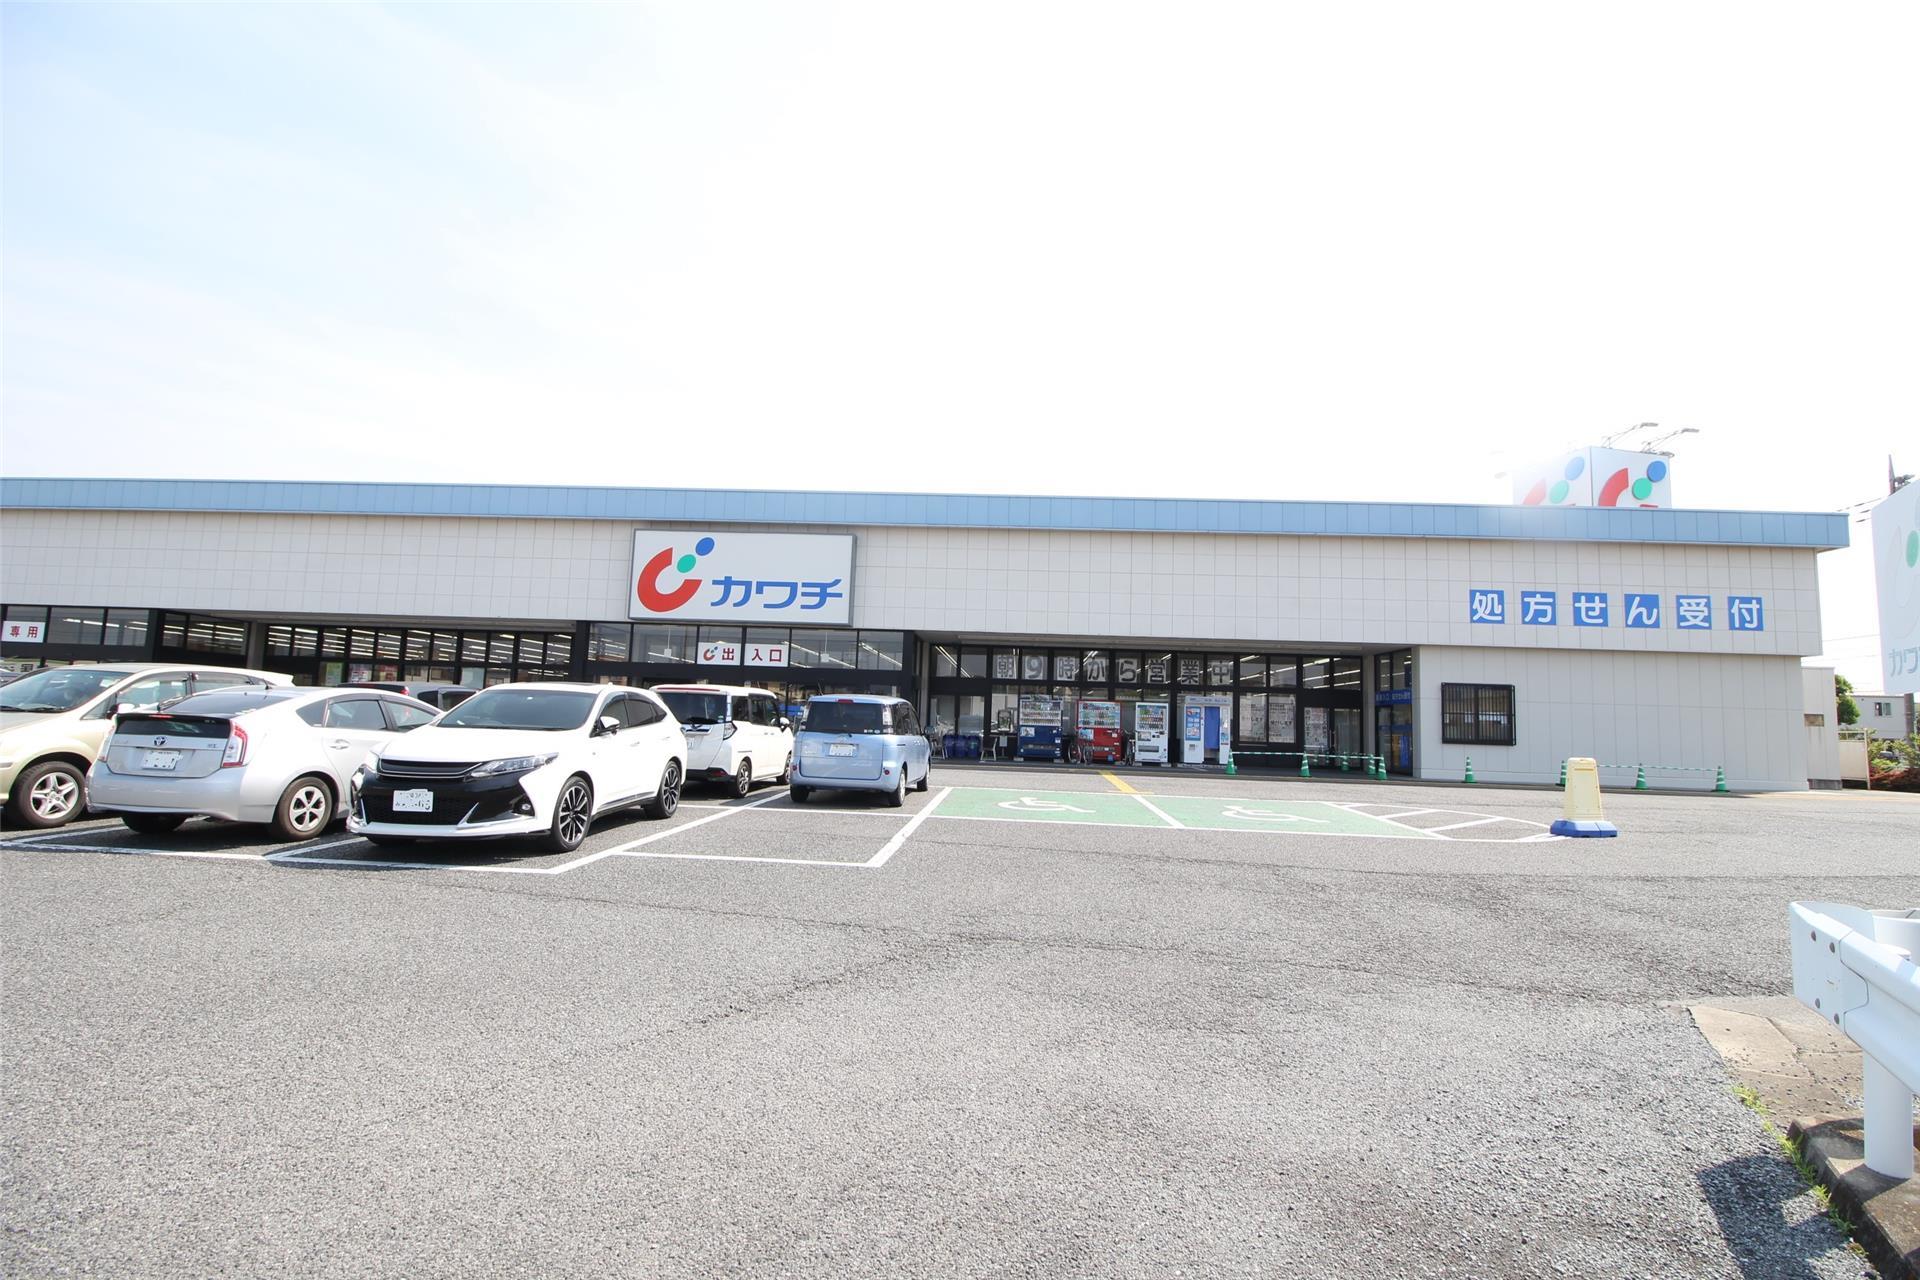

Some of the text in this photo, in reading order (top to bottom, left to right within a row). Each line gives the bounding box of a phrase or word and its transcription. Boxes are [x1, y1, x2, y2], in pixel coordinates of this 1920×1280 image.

[710, 575, 842, 609] カワチ
[1472, 592, 1760, 629] 処方せん受付
[10, 625, 38, 638] 専用
[998, 655, 1229, 684] 朝9時から営業中
[1889, 646, 1920, 676] カワ
